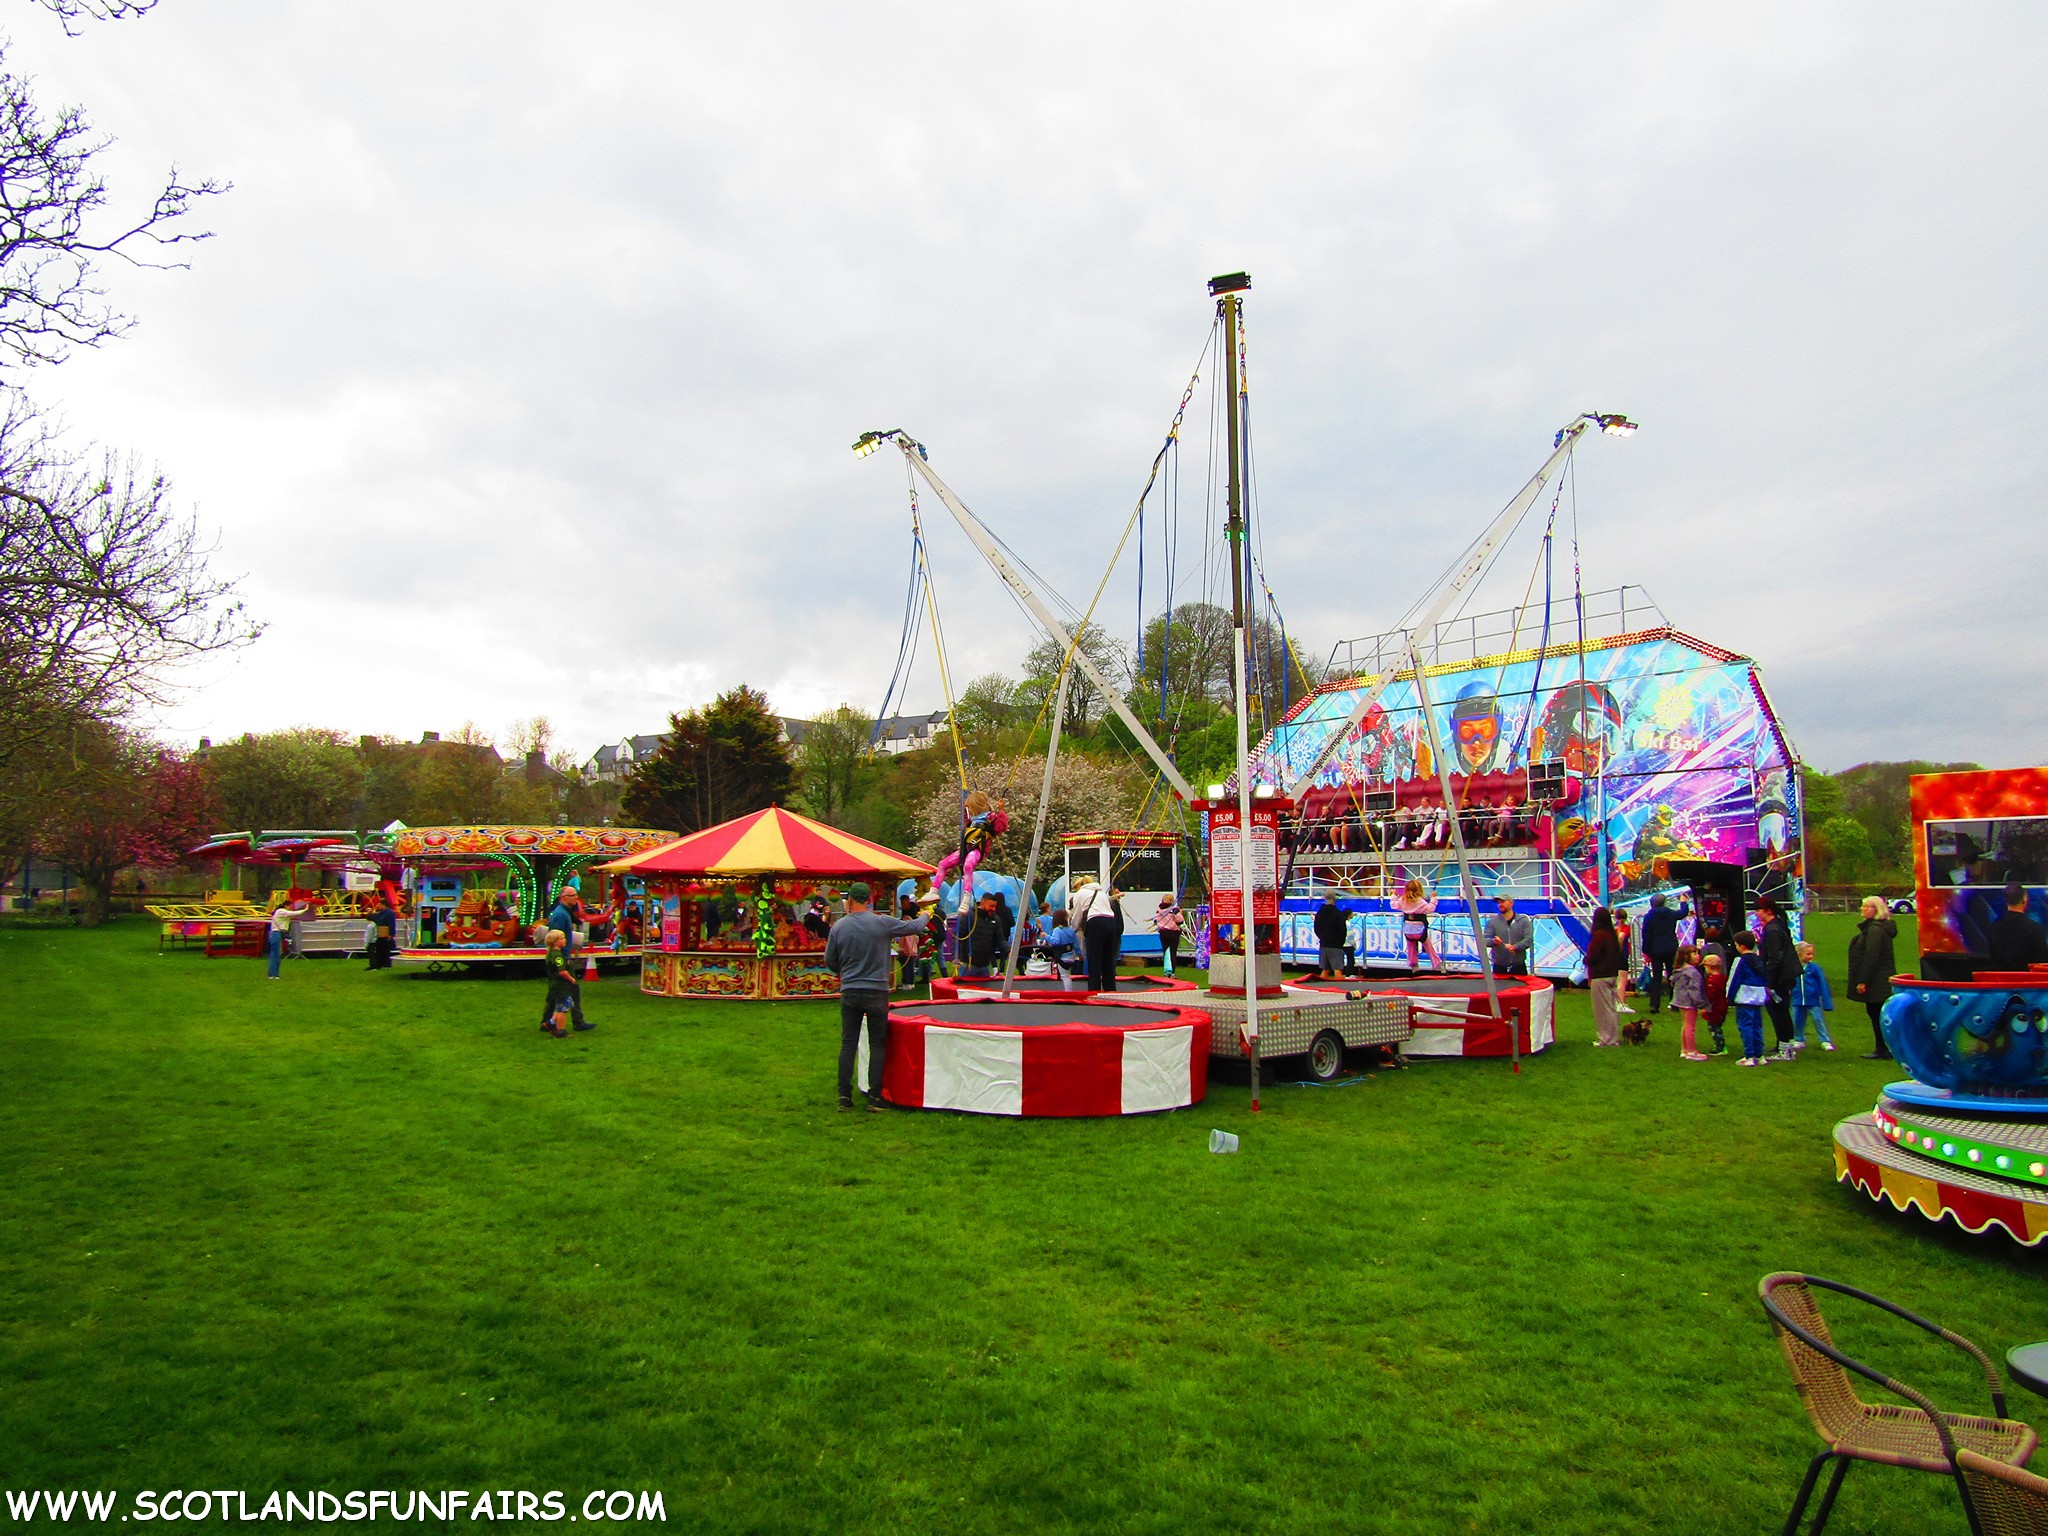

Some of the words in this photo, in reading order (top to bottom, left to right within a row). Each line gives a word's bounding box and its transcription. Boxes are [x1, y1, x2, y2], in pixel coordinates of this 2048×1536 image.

[1669, 735, 1700, 751] Bar
[1305, 720, 1354, 779] bungeetrampolines
[1215, 814, 1234, 822] £5.00
[1254, 813, 1271, 821] £5.00
[1121, 850, 1135, 858] PAY
[1138, 850, 1160, 858] HERE
